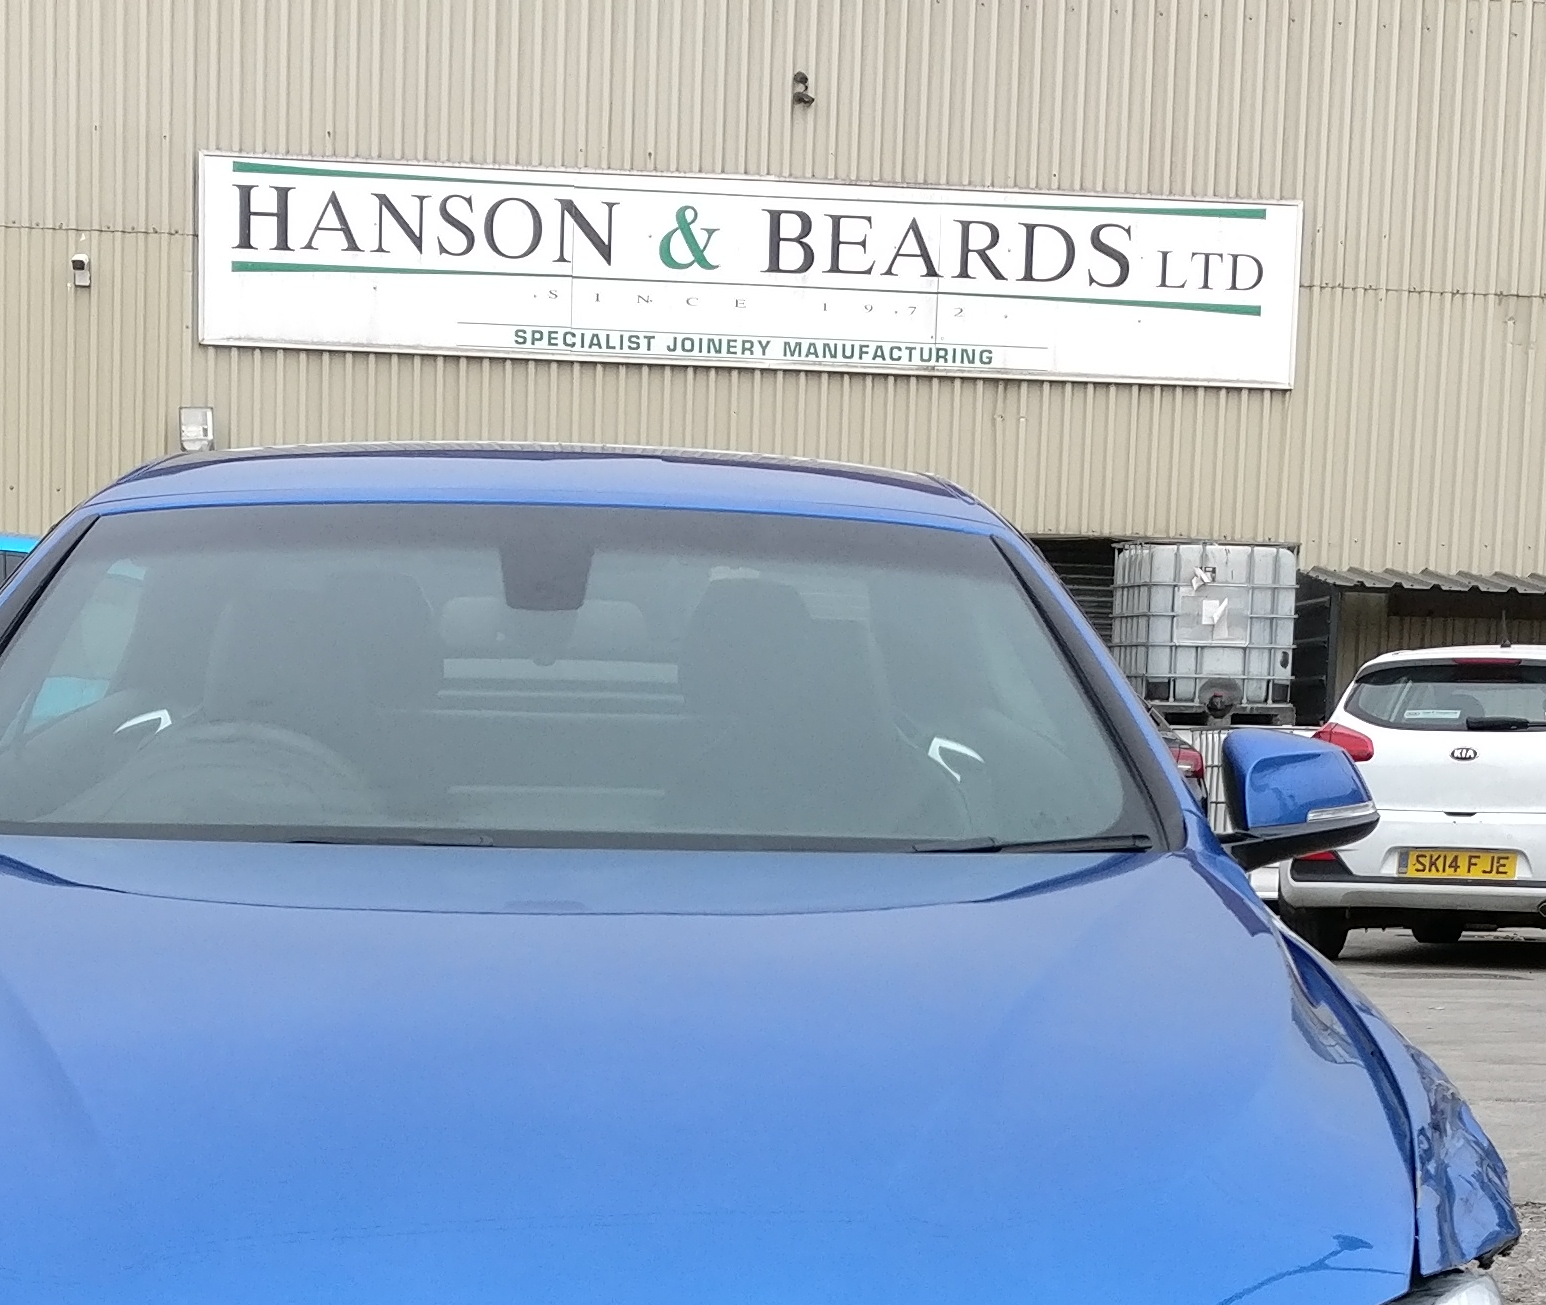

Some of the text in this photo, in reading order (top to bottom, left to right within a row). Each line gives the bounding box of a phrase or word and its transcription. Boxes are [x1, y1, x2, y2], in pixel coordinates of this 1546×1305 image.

[231, 184, 1265, 291] HANSON & BEARDS LTD
[514, 328, 994, 366] SPECIALIST JOINERY MANUFACTURING
[1452, 748, 1476, 759] KIA
[1414, 853, 1510, 875] SK14 FJE
